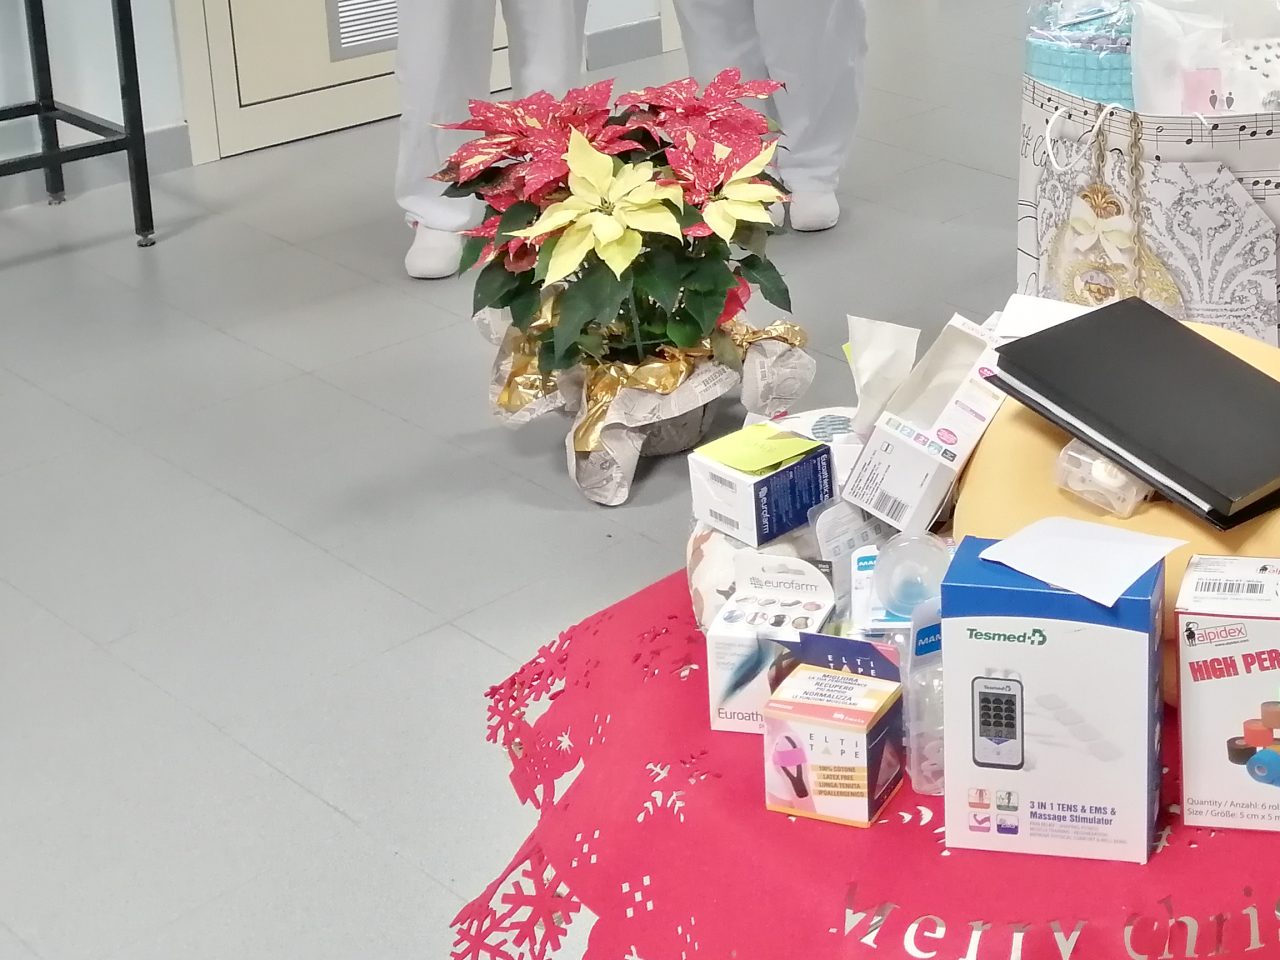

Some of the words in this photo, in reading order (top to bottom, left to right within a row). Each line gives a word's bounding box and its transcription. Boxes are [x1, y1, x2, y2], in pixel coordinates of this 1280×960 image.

[764, 579, 818, 591] eurofarm
[966, 628, 1028, 643] Tesmed
[1196, 626, 1245, 644] alpidex
[1188, 656, 1240, 682] HIGH
[1029, 801, 1035, 809] 3
[1037, 802, 1046, 810] IN
[1057, 803, 1078, 813] TENS
[1080, 805, 1087, 814] &
[1089, 806, 1108, 815] EMS
[1110, 808, 1117, 816] &
[1186, 797, 1222, 808] Quantity
[1229, 801, 1260, 809] Anzahl:
[1261, 802, 1267, 810] 6
[1029, 811, 1067, 823] Massage
[1069, 814, 1113, 826] Stimulator
[1187, 808, 1204, 816] Size
